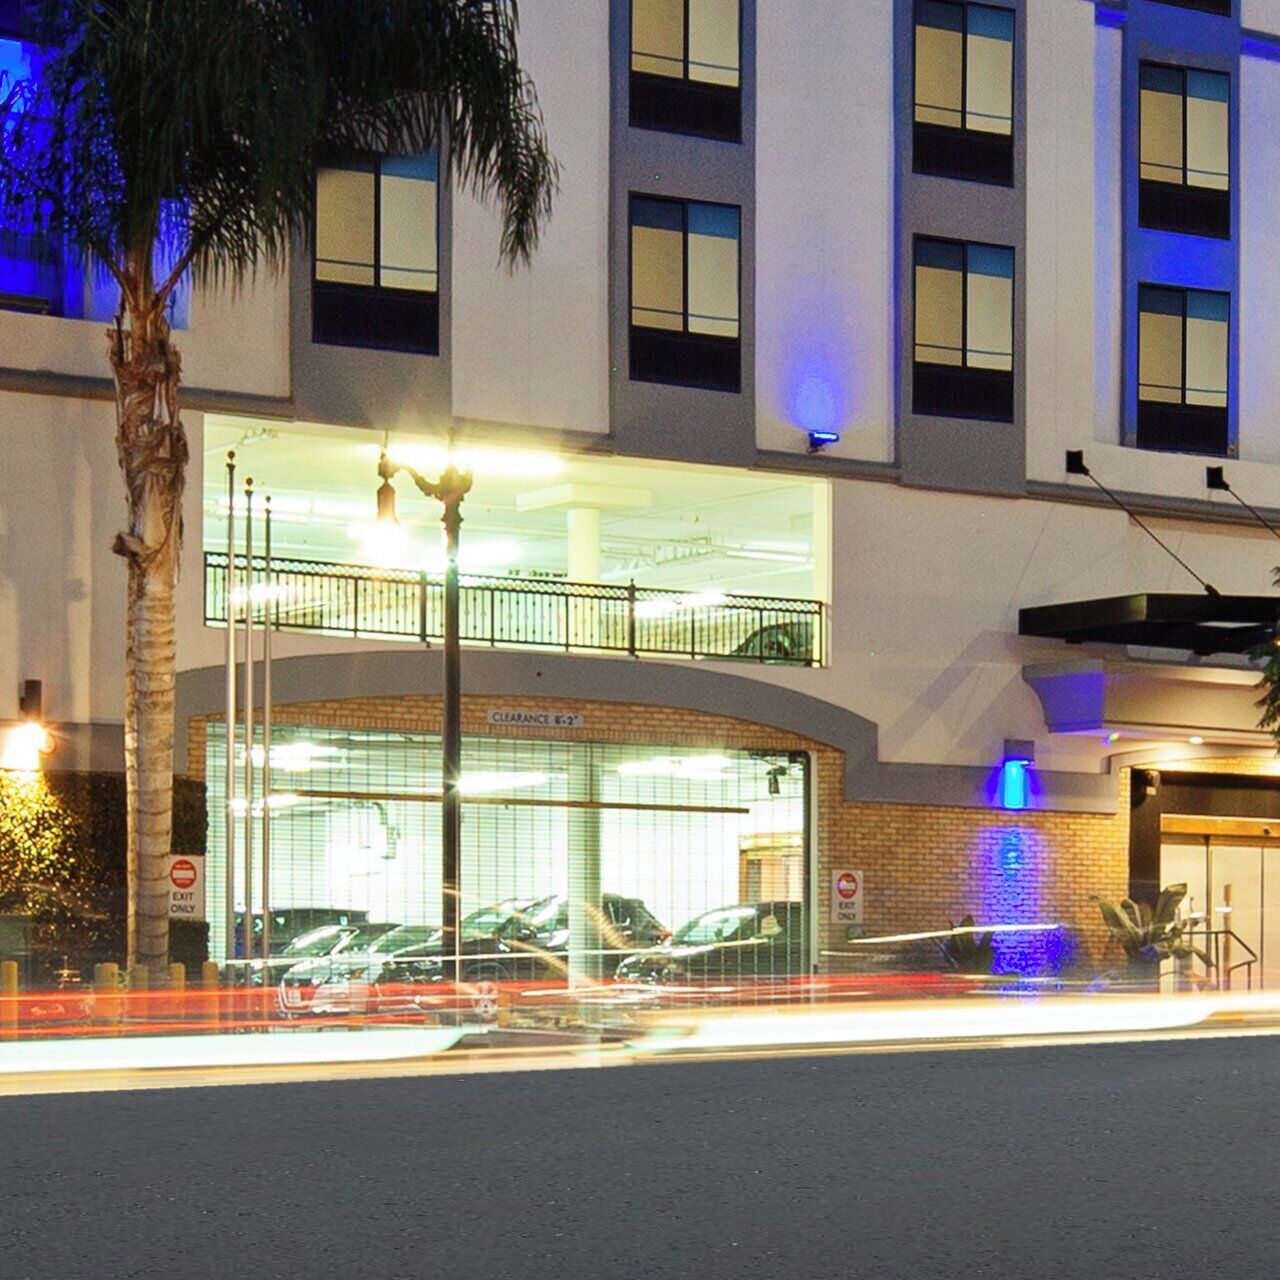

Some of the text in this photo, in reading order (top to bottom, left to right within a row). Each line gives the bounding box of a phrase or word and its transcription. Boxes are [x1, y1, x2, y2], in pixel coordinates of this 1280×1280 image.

[492, 712, 550, 724] CLEARANCE
[173, 892, 194, 901] EXIT
[170, 904, 196, 913] ONLY
[839, 901, 855, 910] EXIT
[837, 912, 857, 921] ONLY
